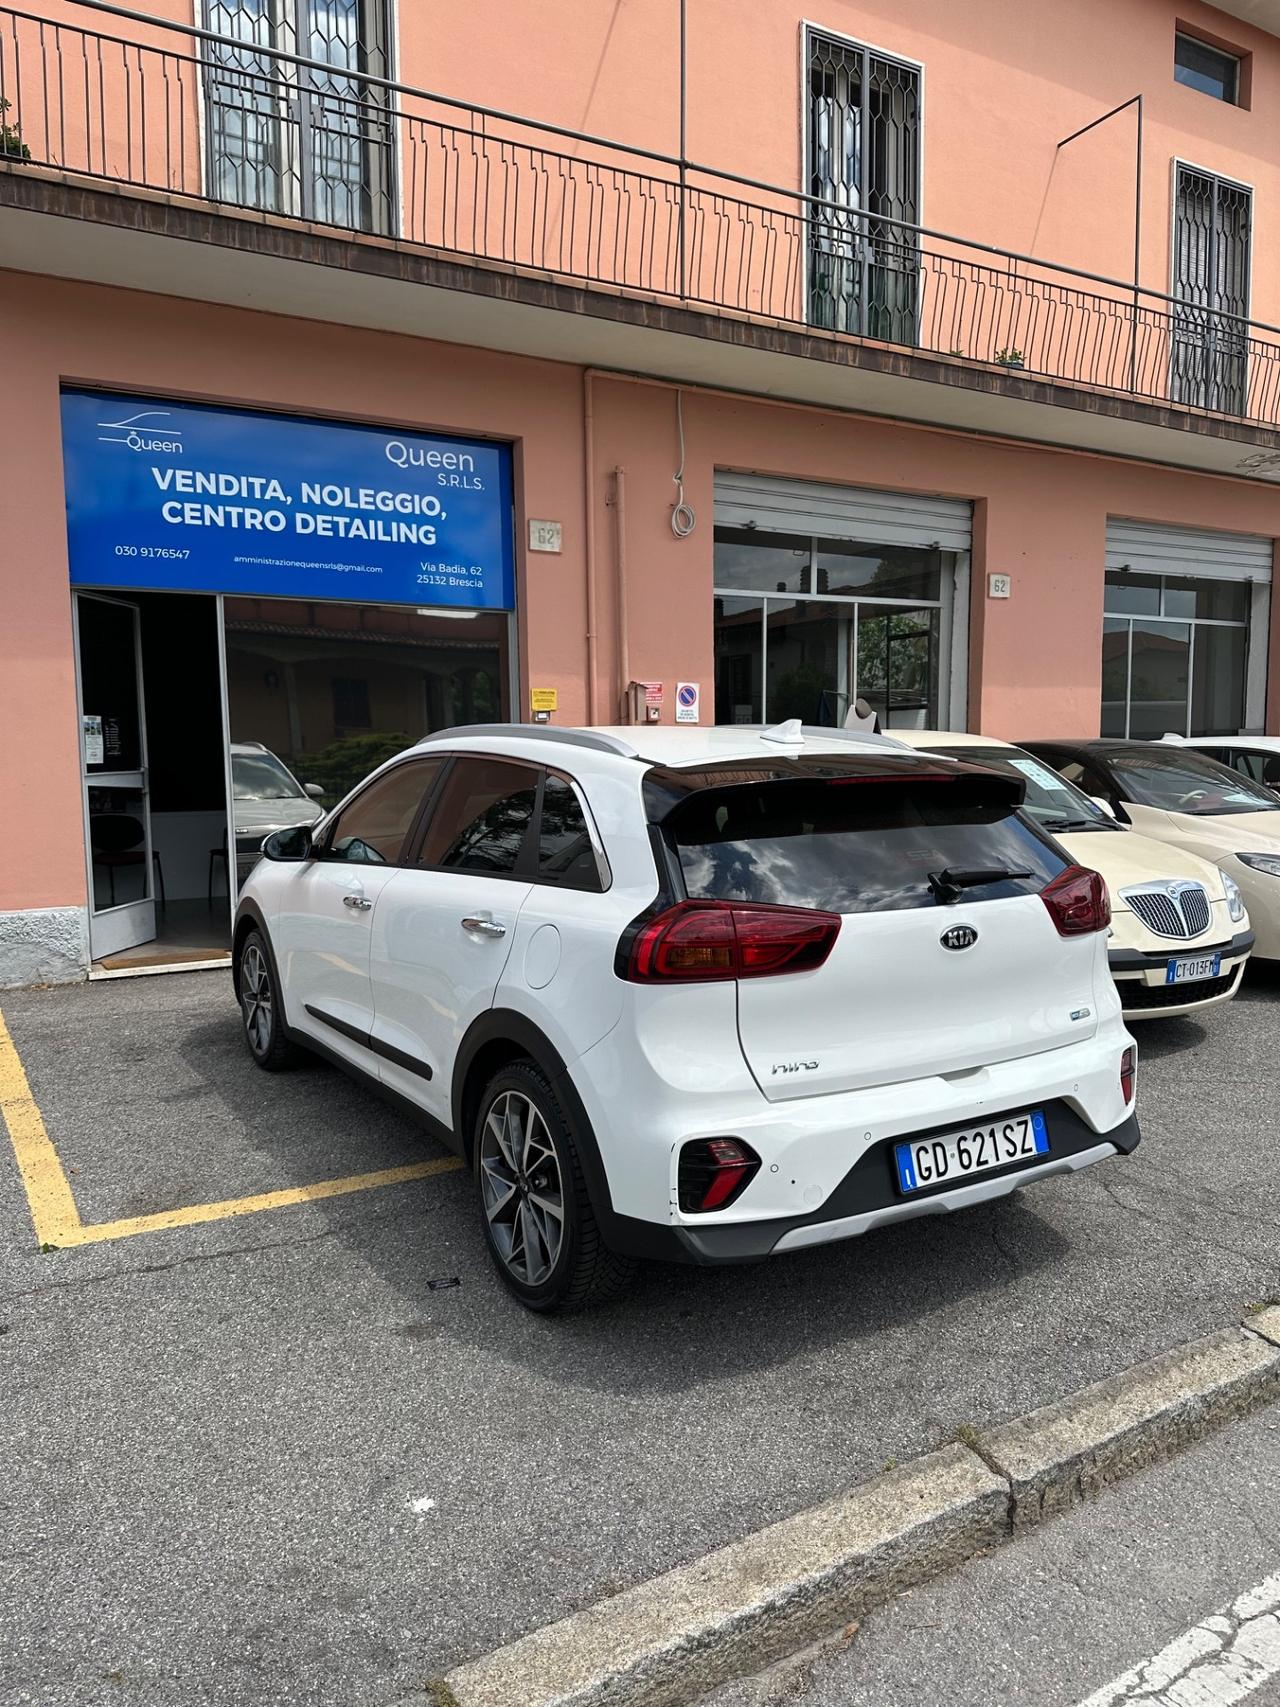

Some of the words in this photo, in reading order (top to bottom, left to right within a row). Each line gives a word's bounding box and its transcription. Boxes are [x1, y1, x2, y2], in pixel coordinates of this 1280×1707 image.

[127, 435, 183, 453] Queen
[385, 441, 474, 472] Queen
[437, 473, 485, 490] S.R.L.S.
[151, 467, 292, 505] VENDITA,
[301, 482, 447, 520] NOLEGGIO,
[162, 501, 287, 532] CENTRO
[295, 512, 436, 545] DETAILING
[115, 545, 138, 557] 030
[140, 547, 190, 560] 9176547
[233, 555, 383, 574] amministrazionequeensrls@gmail.com
[420, 561, 437, 572] Via
[439, 563, 469, 576] Badia,
[470, 566, 483, 576] 62
[416, 574, 447, 585] 25132
[449, 576, 484, 588] Brescia
[994, 579, 1006, 593] 62
[948, 929, 974, 946] KIA
